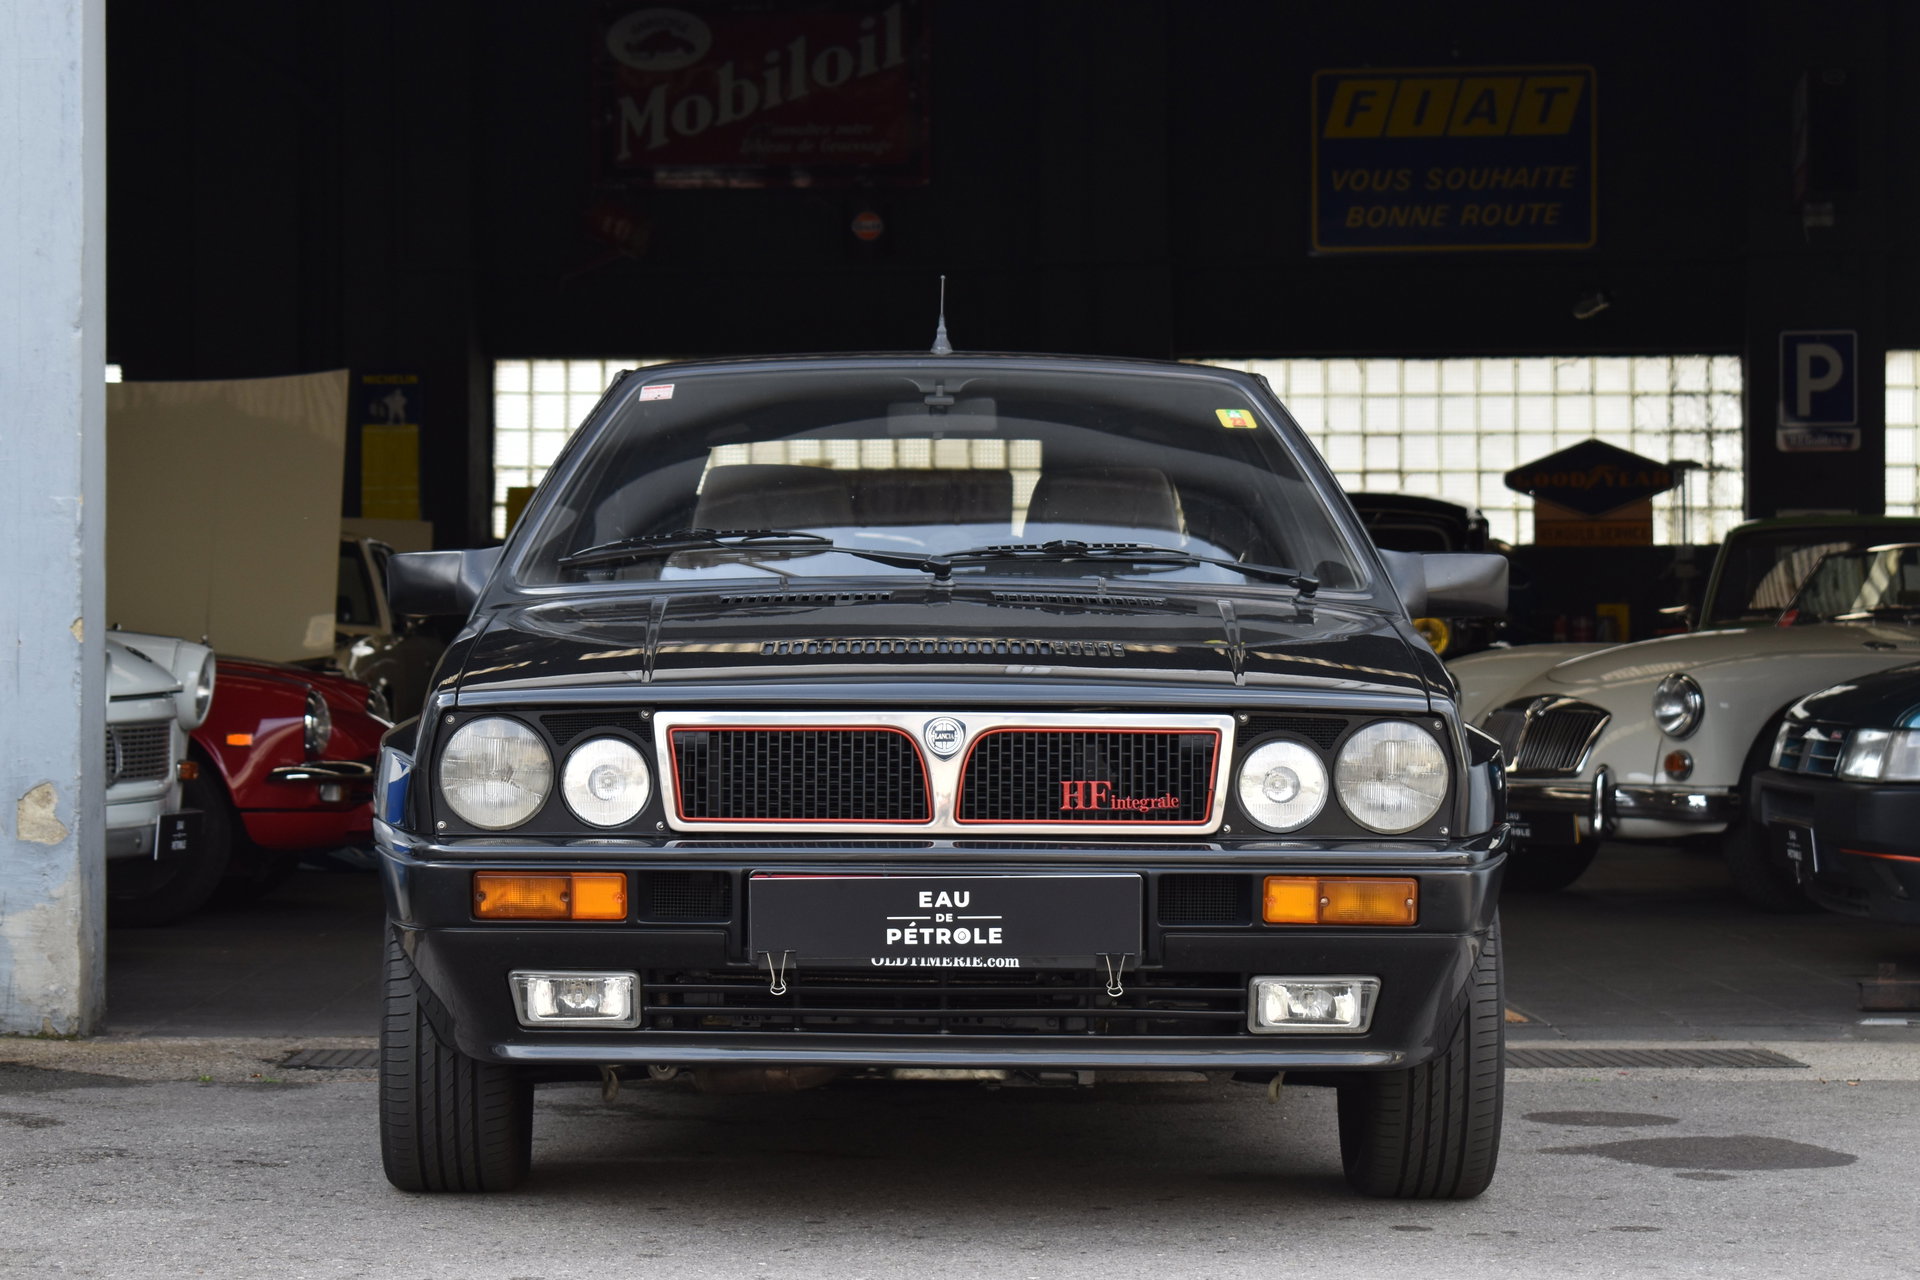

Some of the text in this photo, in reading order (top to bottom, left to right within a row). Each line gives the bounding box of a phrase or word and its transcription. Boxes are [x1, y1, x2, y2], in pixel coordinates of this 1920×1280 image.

[617, 2, 905, 161] Mobiloil
[1343, 86, 1571, 128] FIAT
[1330, 166, 1578, 192] VOUS SOUHAITE
[1345, 202, 1563, 228] BONNE ROUTE
[1795, 342, 1844, 417] P
[1059, 780, 1180, 813] HF integrale
[919, 891, 970, 908] EAU
[935, 913, 954, 923] DE
[886, 921, 1003, 945] PÉTROLE
